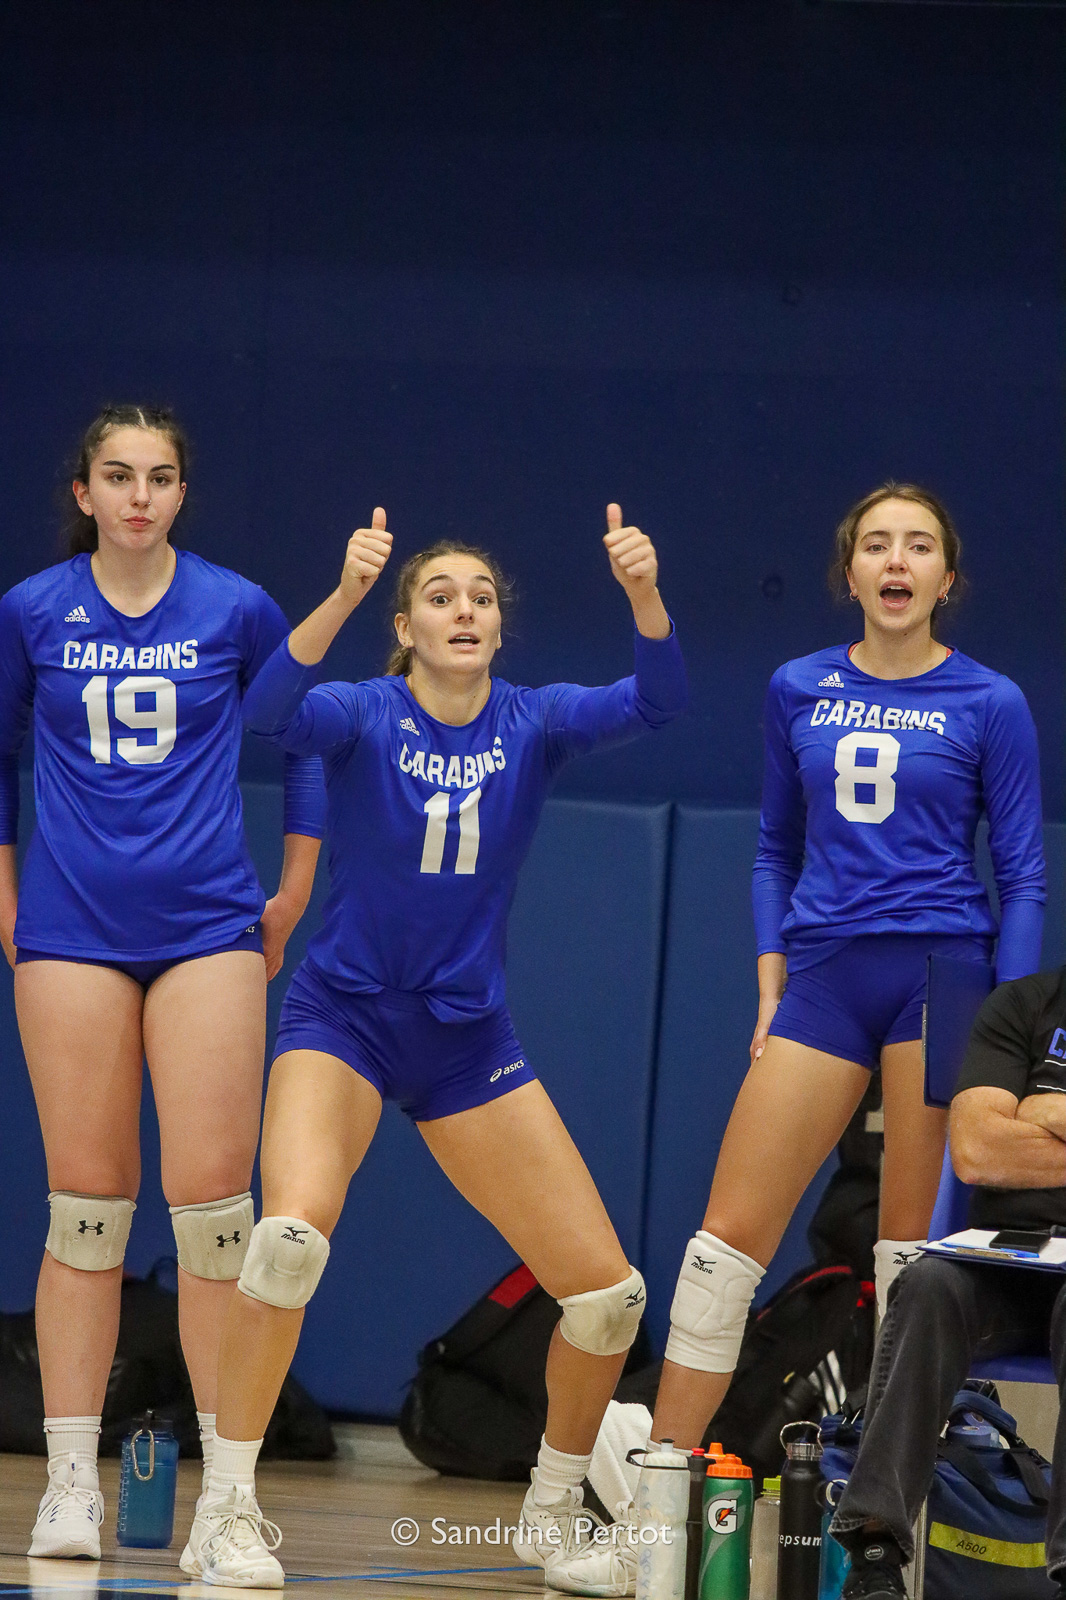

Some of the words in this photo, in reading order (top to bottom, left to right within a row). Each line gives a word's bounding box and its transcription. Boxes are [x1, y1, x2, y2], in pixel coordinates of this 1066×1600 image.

[65, 615, 91, 623] adidas
[63, 639, 198, 669] CARABINS
[817, 680, 845, 689] adidas
[81, 675, 177, 764] 19
[810, 698, 947, 736] CARABINS
[399, 736, 506, 790] CARABINS
[834, 731, 901, 824] 8
[419, 786, 482, 875] 11
[503, 1059, 525, 1075] asics
[707, 1498, 738, 1535] G
[778, 1534, 822, 1548] epsum
[956, 1539, 987, 1555] A500
